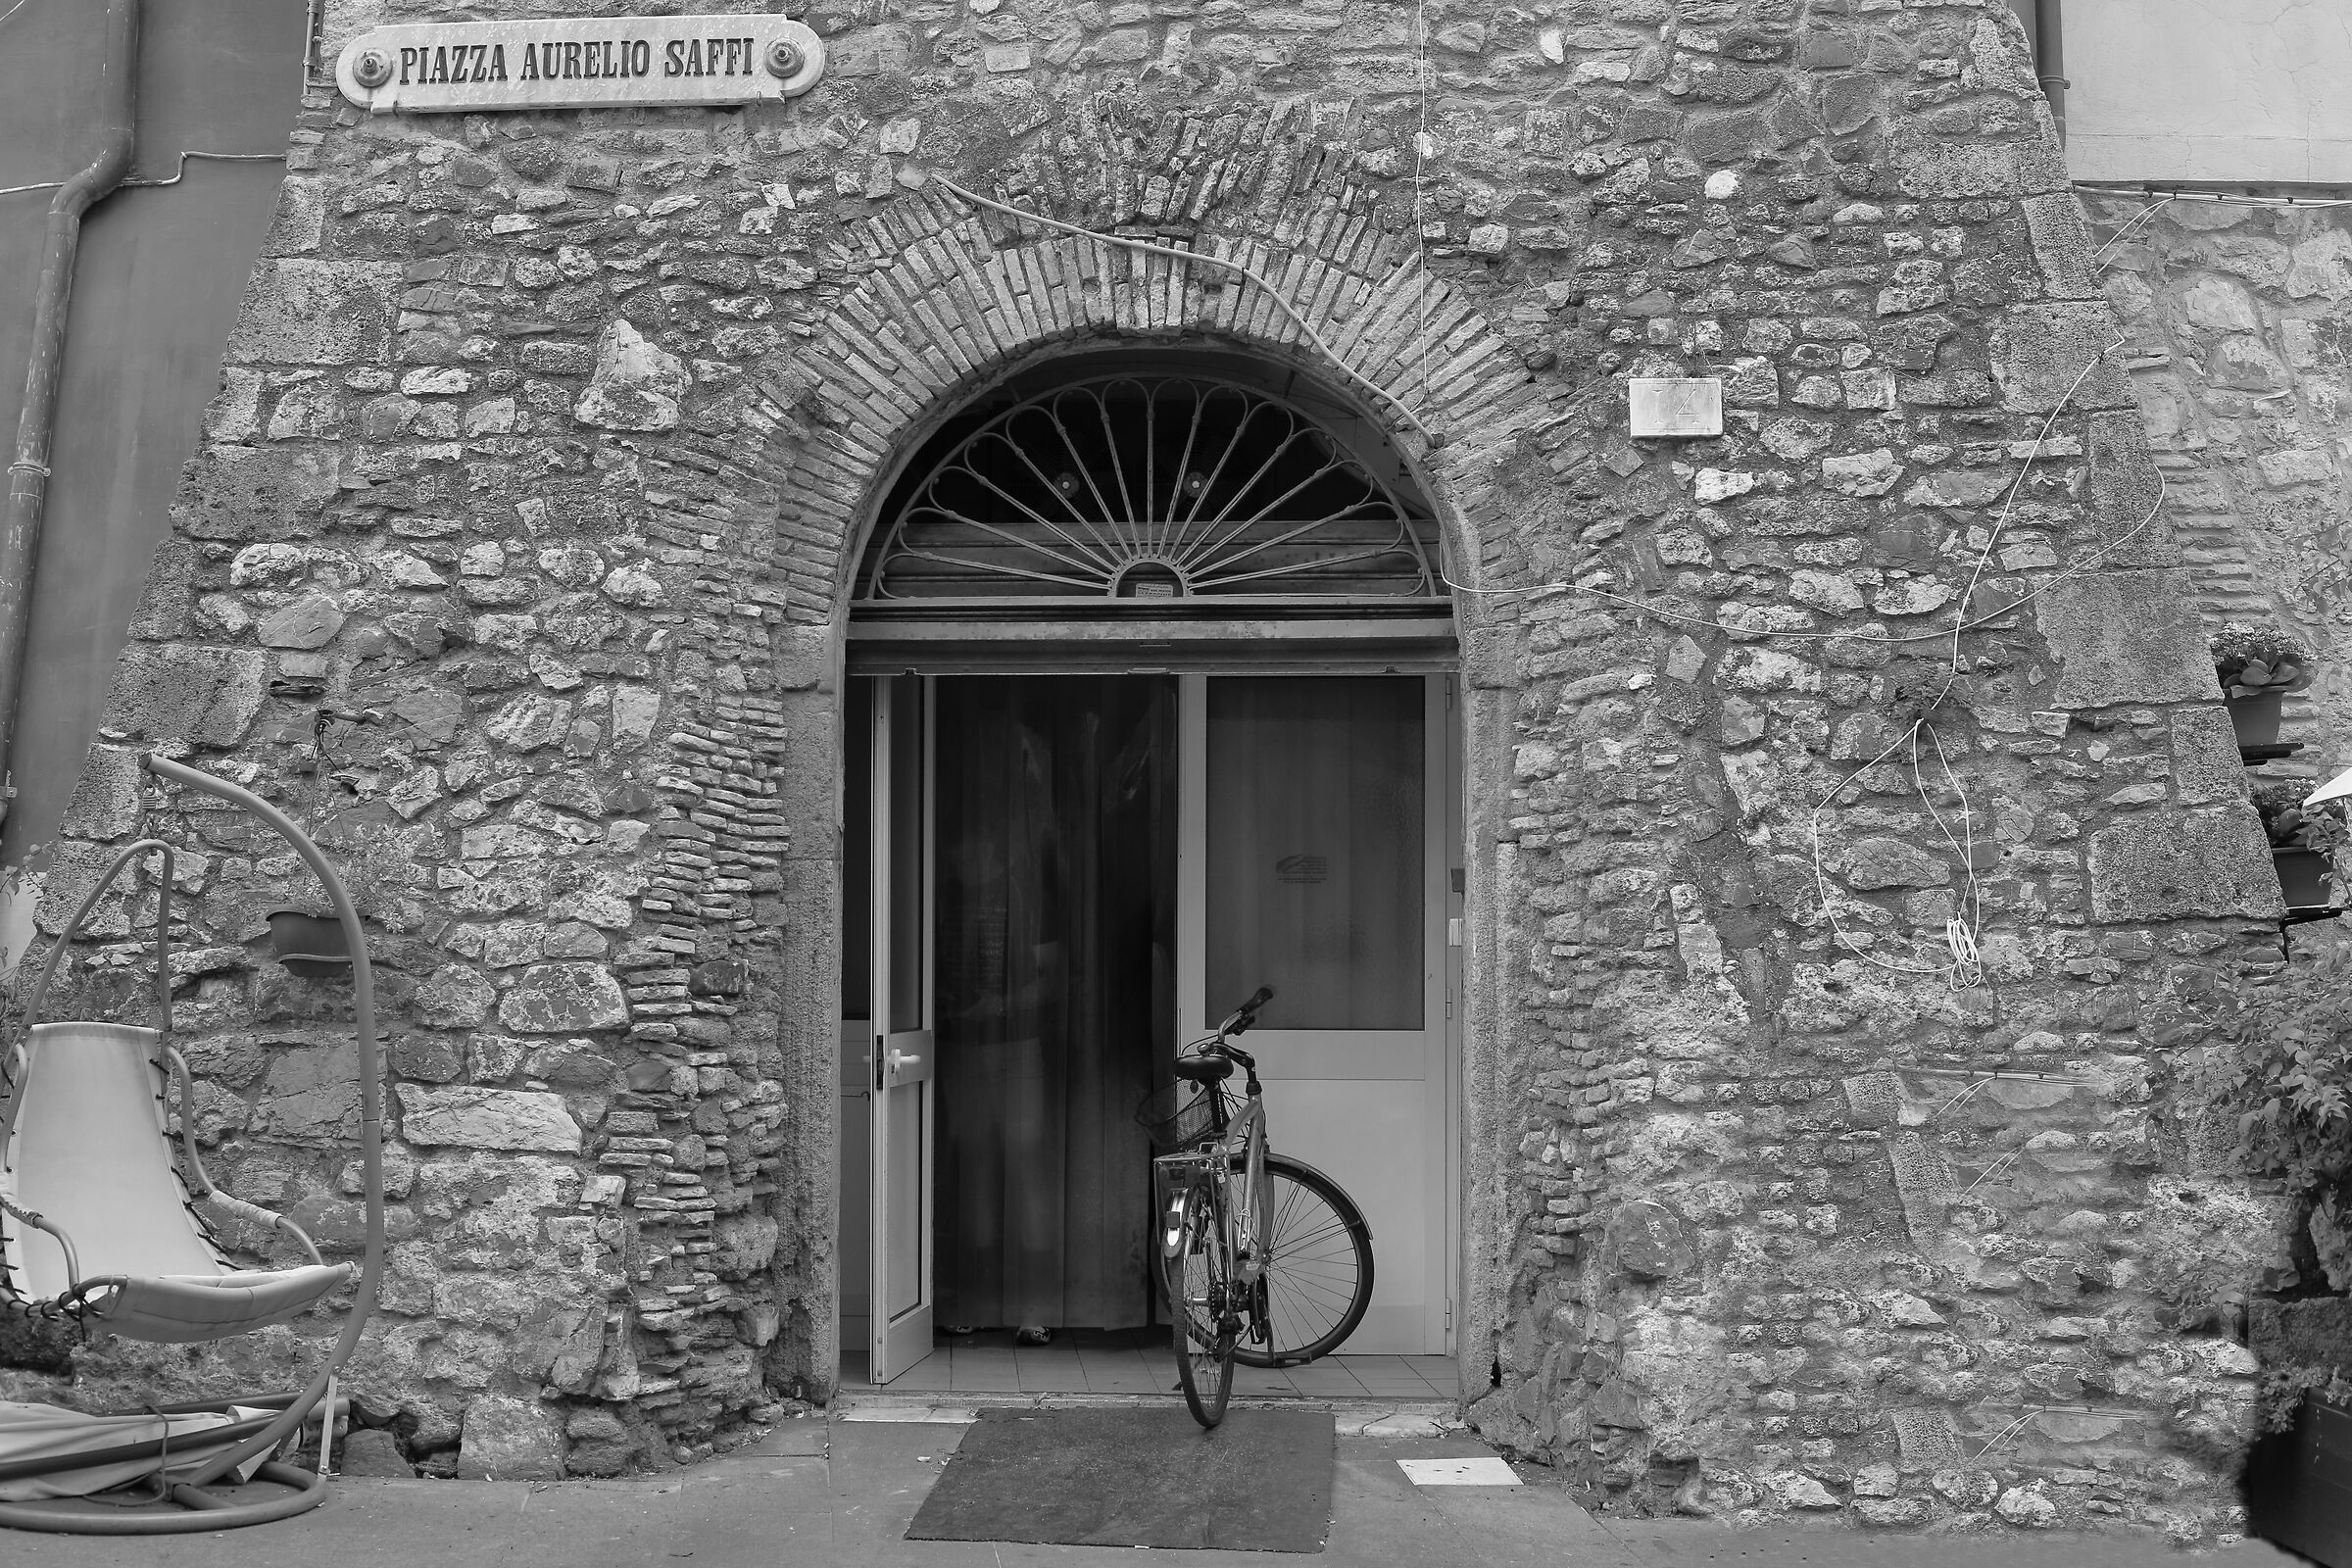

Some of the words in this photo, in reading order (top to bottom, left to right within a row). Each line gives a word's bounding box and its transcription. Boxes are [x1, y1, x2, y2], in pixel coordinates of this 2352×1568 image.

[399, 45, 509, 85] PIAZZA
[520, 39, 651, 80] AURELIO
[664, 37, 755, 77] SAFFI
